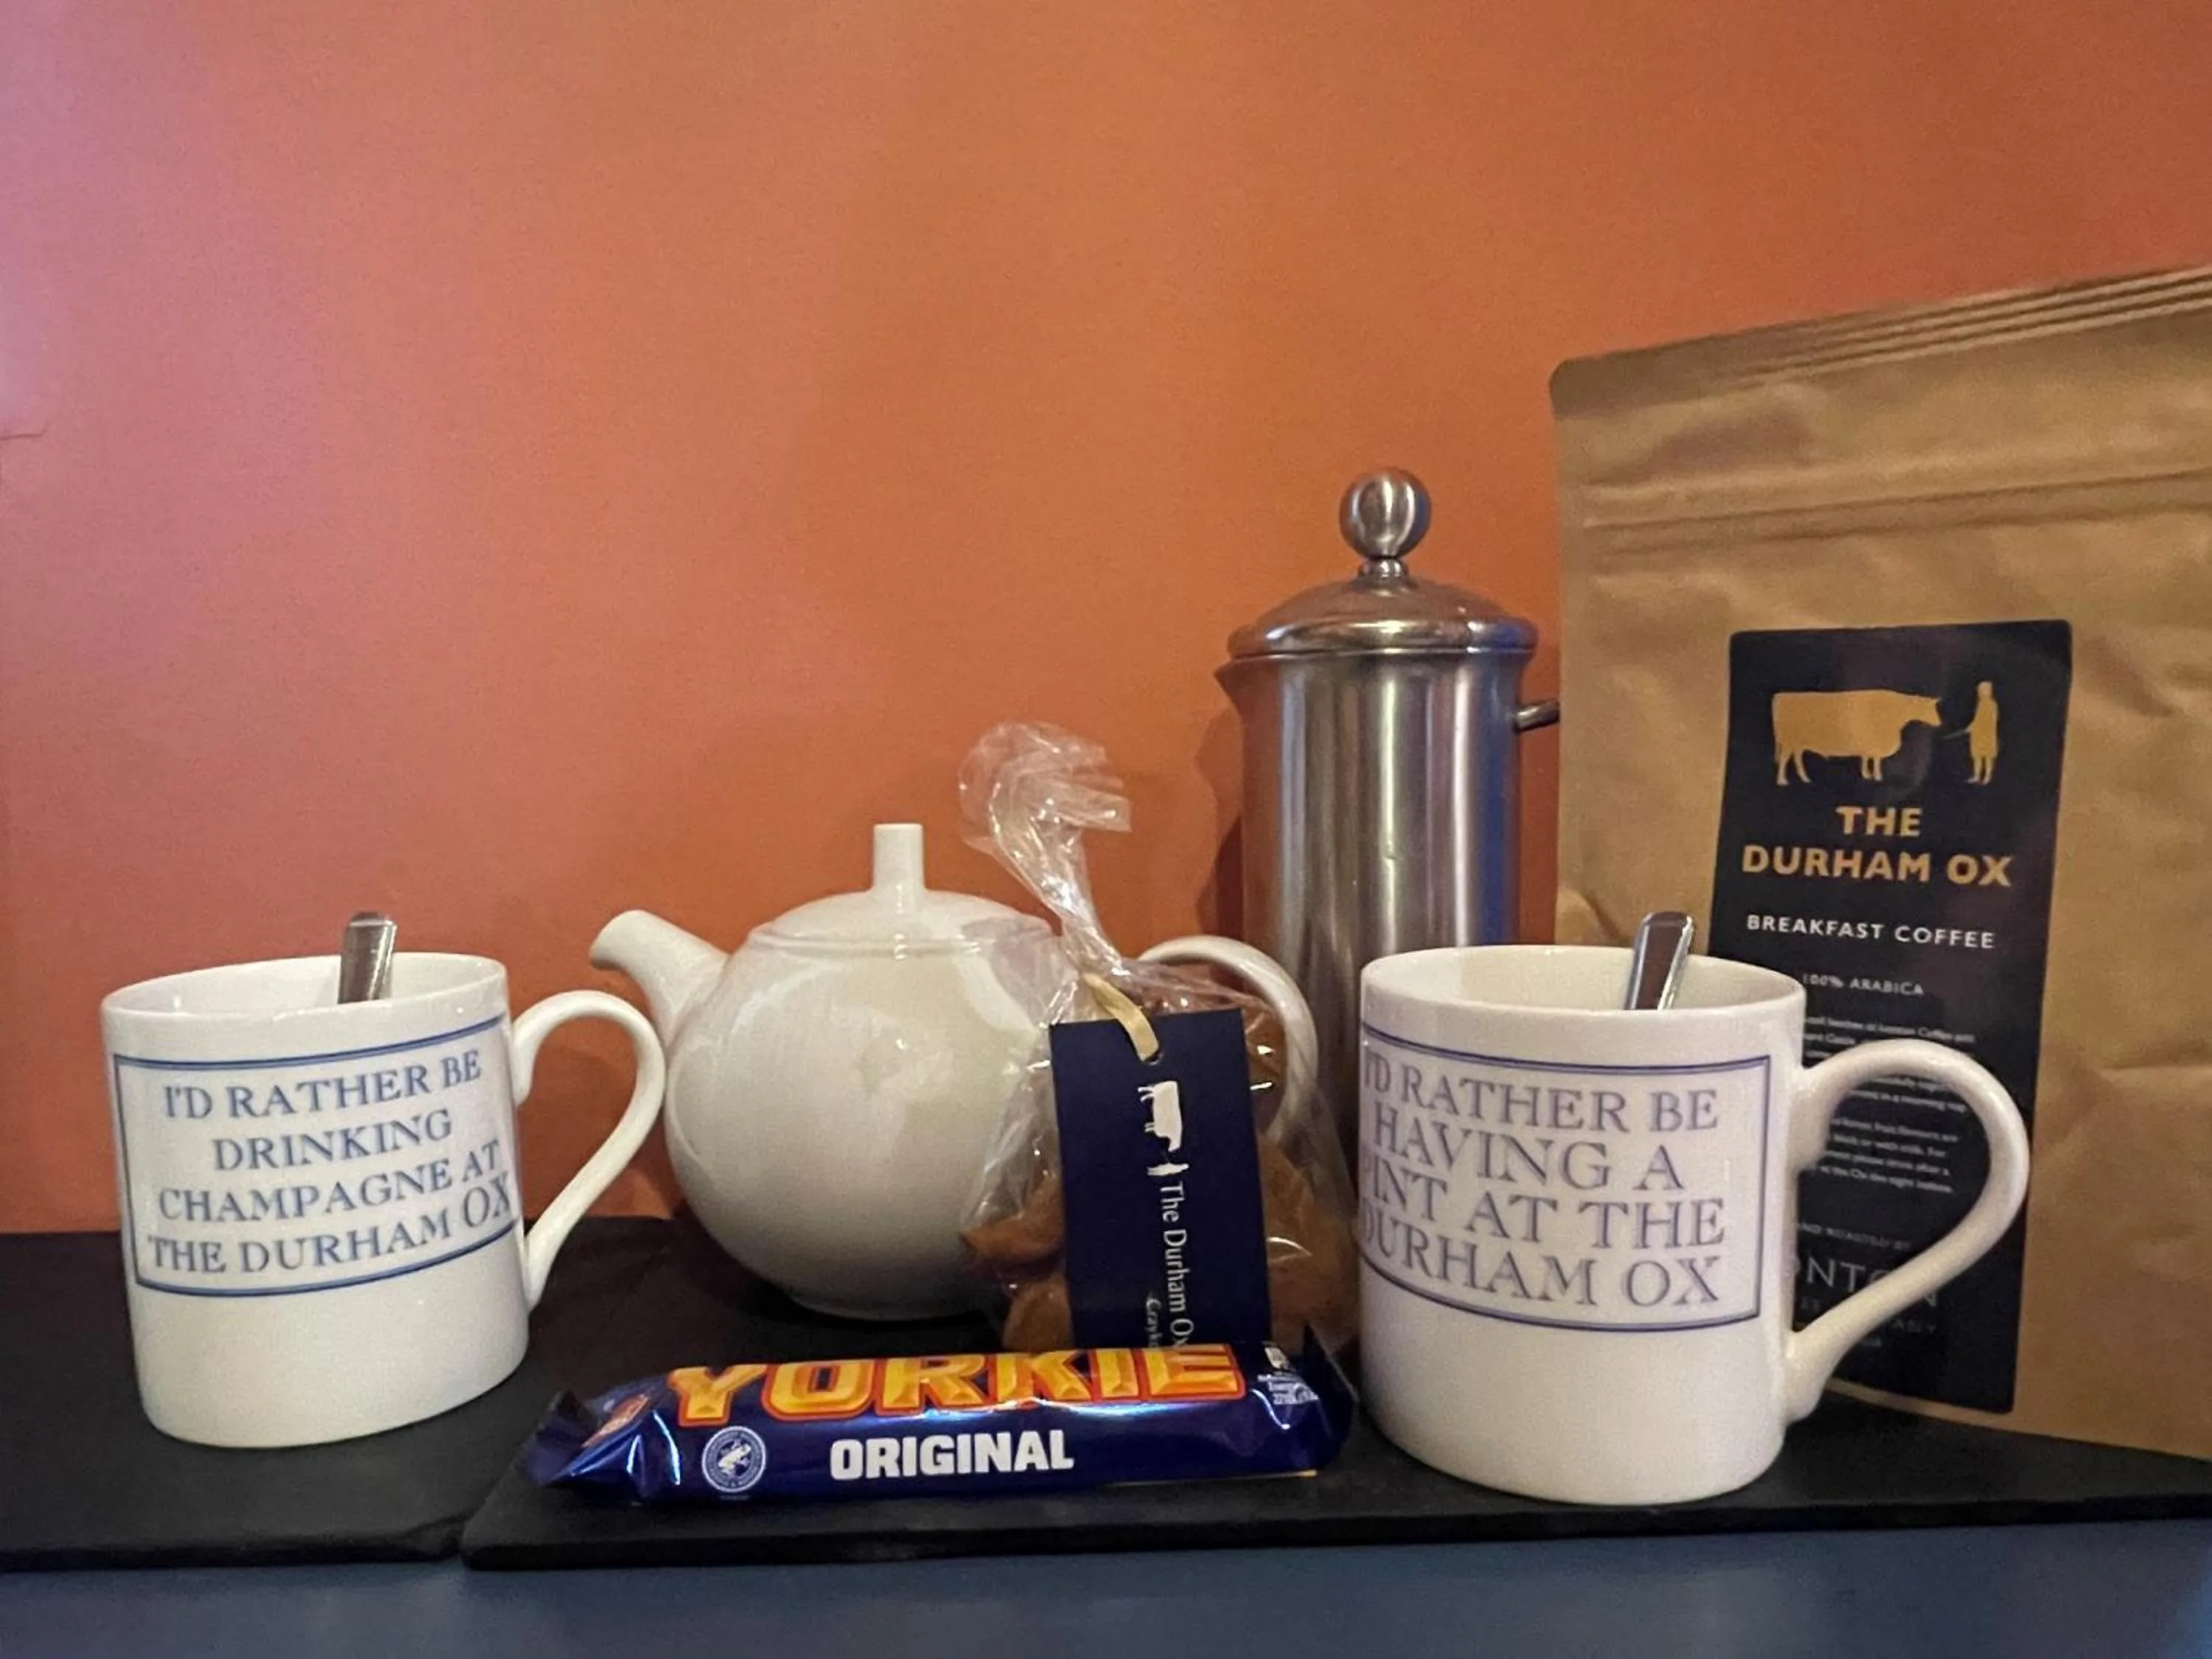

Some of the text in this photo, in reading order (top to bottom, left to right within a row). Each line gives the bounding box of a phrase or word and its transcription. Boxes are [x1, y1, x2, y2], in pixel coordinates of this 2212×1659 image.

[1836, 805, 1923, 838] THE
[1741, 844, 2013, 888] DURHAM OX
[1746, 914, 1997, 950] BREAKFAST COFFEE
[1849, 978, 1924, 996] ARABICA
[164, 1048, 482, 1120] I'D RATHER BE
[1400, 1064, 1630, 1134] RATHER
[1649, 1088, 1719, 1133] BE
[213, 1107, 453, 1171] DRINKING
[1374, 1101, 1685, 1191] HAVING A
[159, 1137, 501, 1222] CHAMPAGNE AT
[1159, 1181, 1186, 1223] The
[147, 1171, 512, 1274] THE DURHAM OX
[1464, 1191, 1559, 1245] AT
[1578, 1197, 1726, 1250] THE
[1163, 1228, 1191, 1313] Durham
[1626, 1256, 1722, 1307] OX
[667, 1343, 1246, 1428] YORKIE
[830, 1429, 1074, 1481] ORIGINAL
